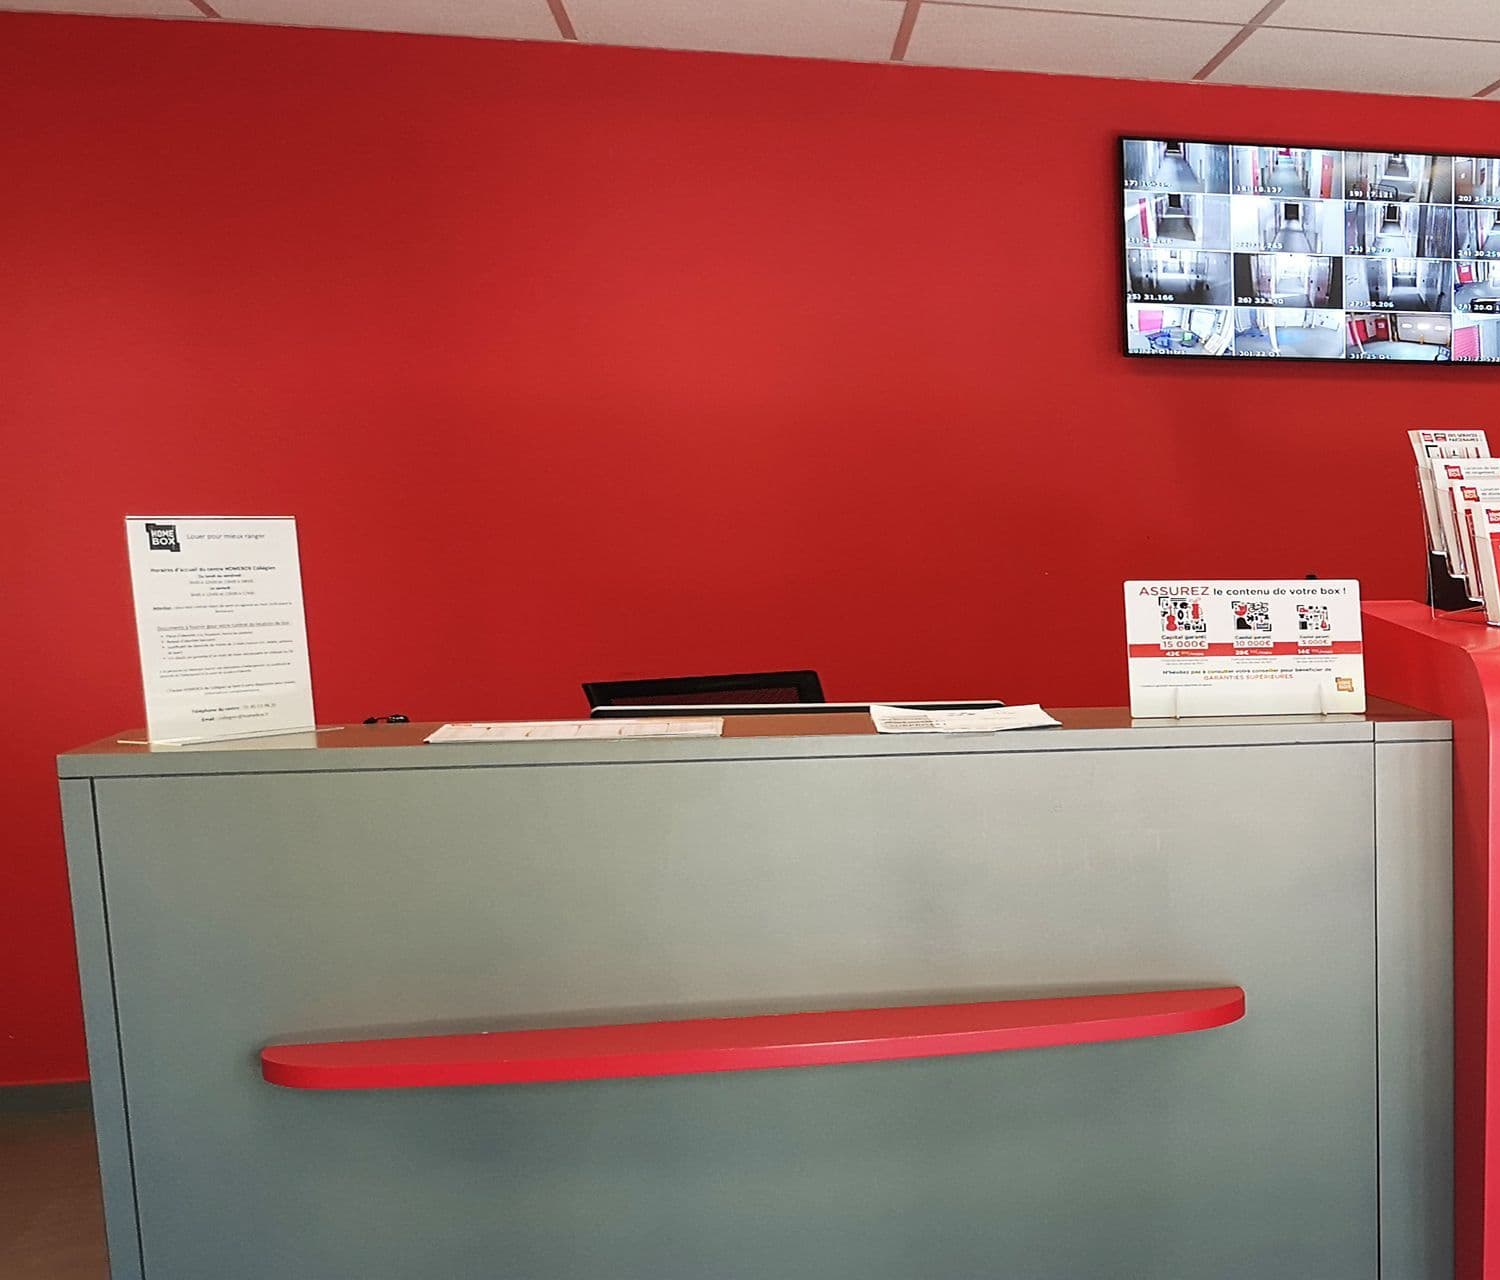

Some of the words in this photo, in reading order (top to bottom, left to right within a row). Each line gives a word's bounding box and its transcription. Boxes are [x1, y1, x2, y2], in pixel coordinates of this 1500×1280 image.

[150, 529, 175, 538] HOME
[152, 537, 177, 546] BOX
[1139, 586, 1209, 596] ASSUREZ
[1213, 588, 1223, 596] le
[1226, 588, 1270, 596] contenu
[1273, 587, 1286, 595] de
[1320, 587, 1340, 595] box
[1163, 640, 1174, 648] 15
[1176, 640, 1207, 648] 000€
